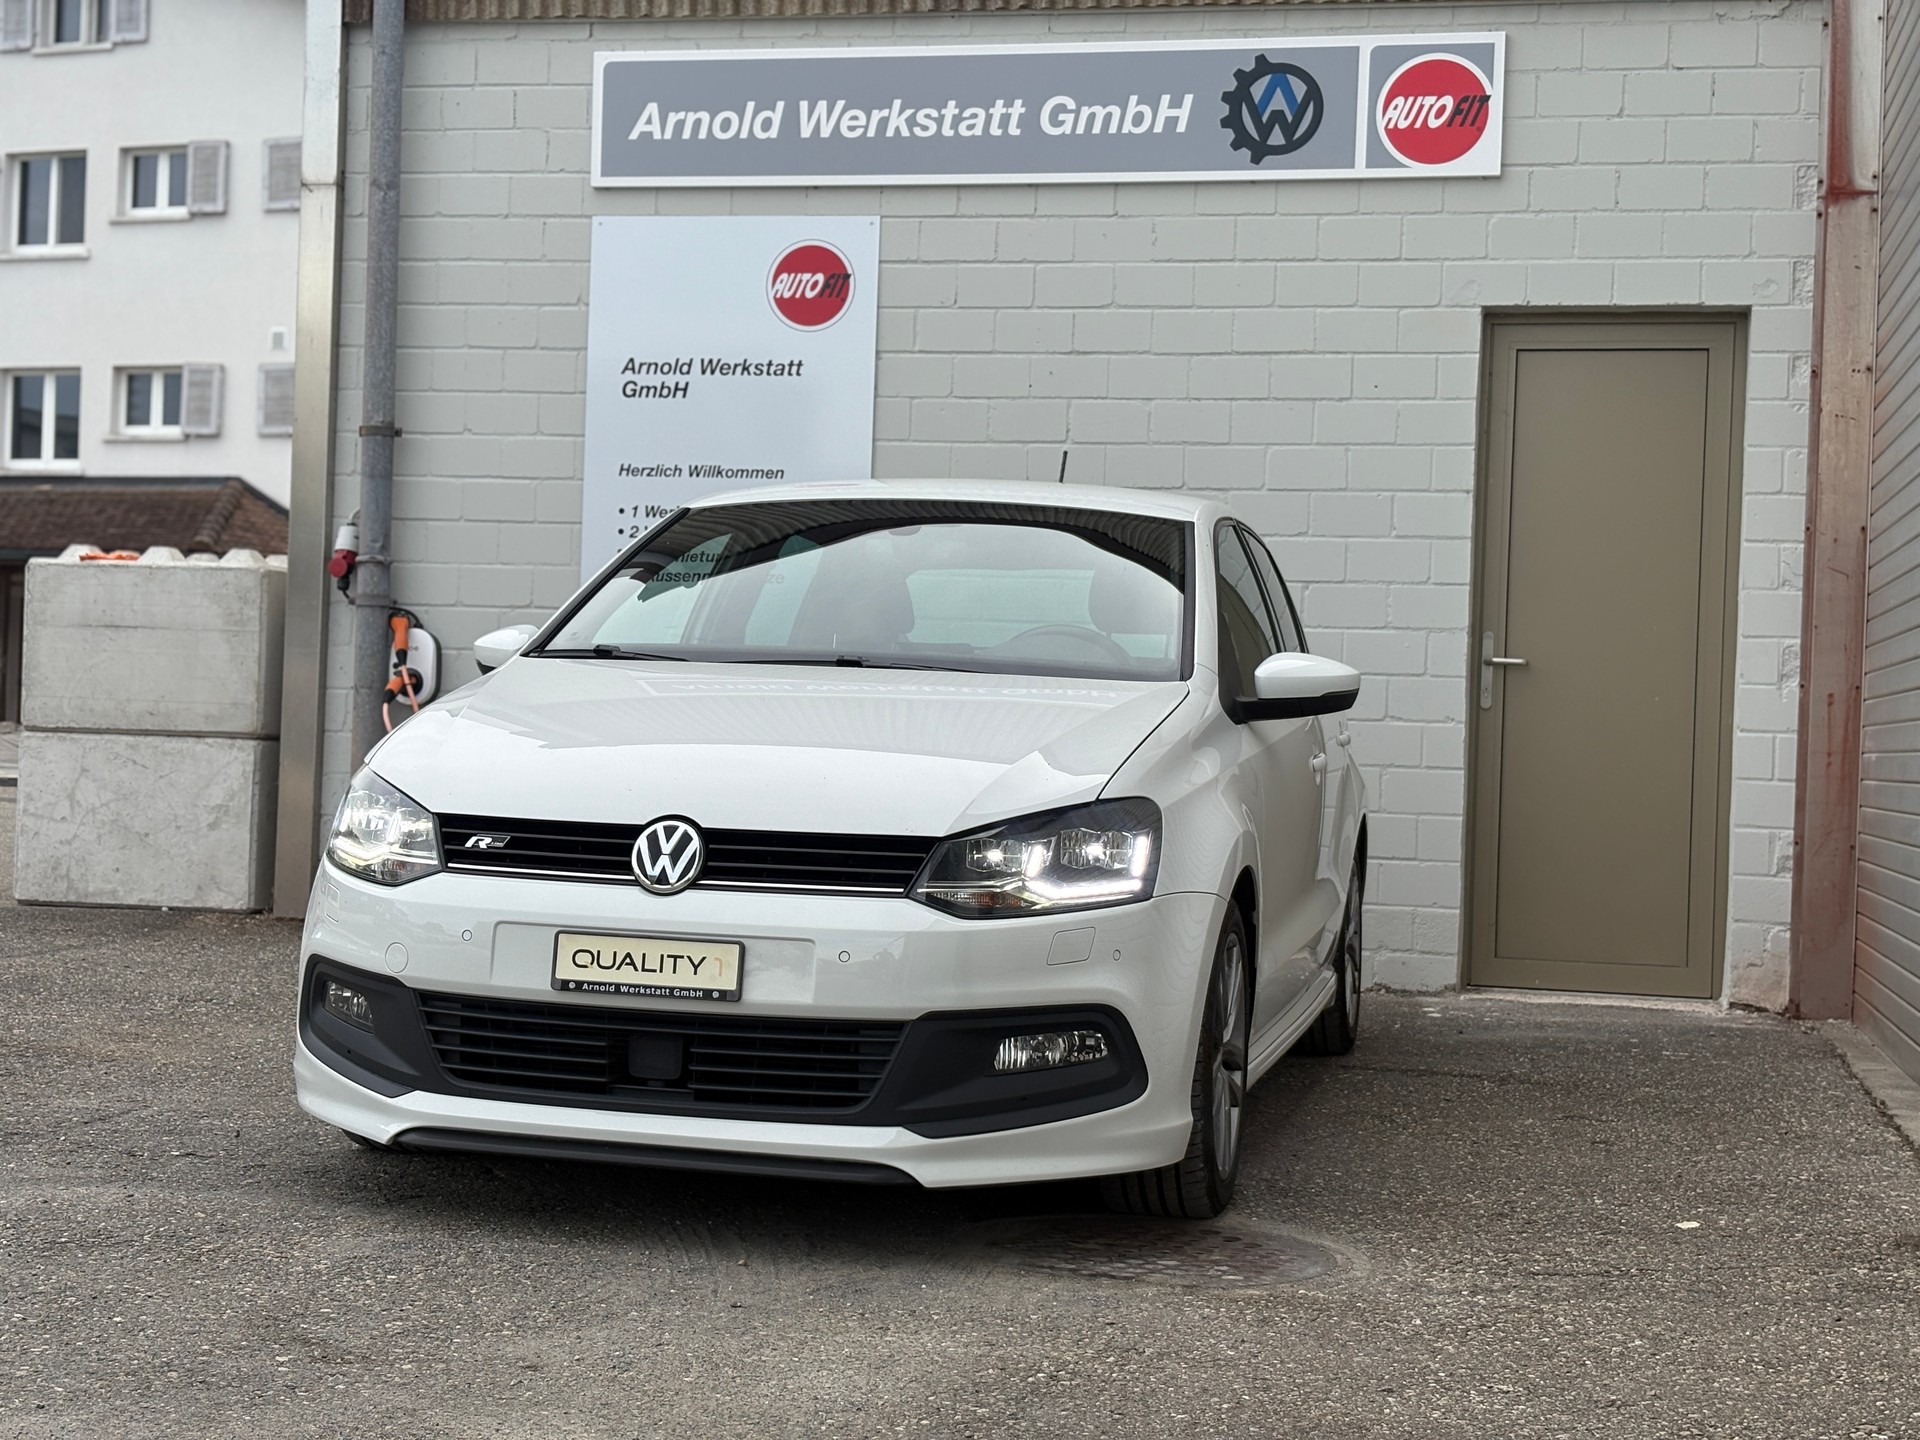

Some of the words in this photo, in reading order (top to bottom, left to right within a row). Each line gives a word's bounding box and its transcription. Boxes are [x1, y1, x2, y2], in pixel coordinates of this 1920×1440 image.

[628, 101, 784, 140] Arnold
[799, 98, 1024, 138] Werkstatt
[1039, 94, 1193, 136] GmbH
[1382, 94, 1492, 129] AUTOFIT
[771, 272, 852, 299] AUTOFIT
[621, 358, 693, 375] Arnold
[700, 358, 803, 376] Werkstatt
[622, 380, 689, 398] GmbH
[618, 463, 682, 478] Herzlich
[688, 465, 785, 480] Willkommen
[572, 949, 707, 976] QUALITY
[582, 982, 615, 992] Arnold
[620, 985, 670, 996] Werkstatt
[673, 988, 703, 998] GmbH
